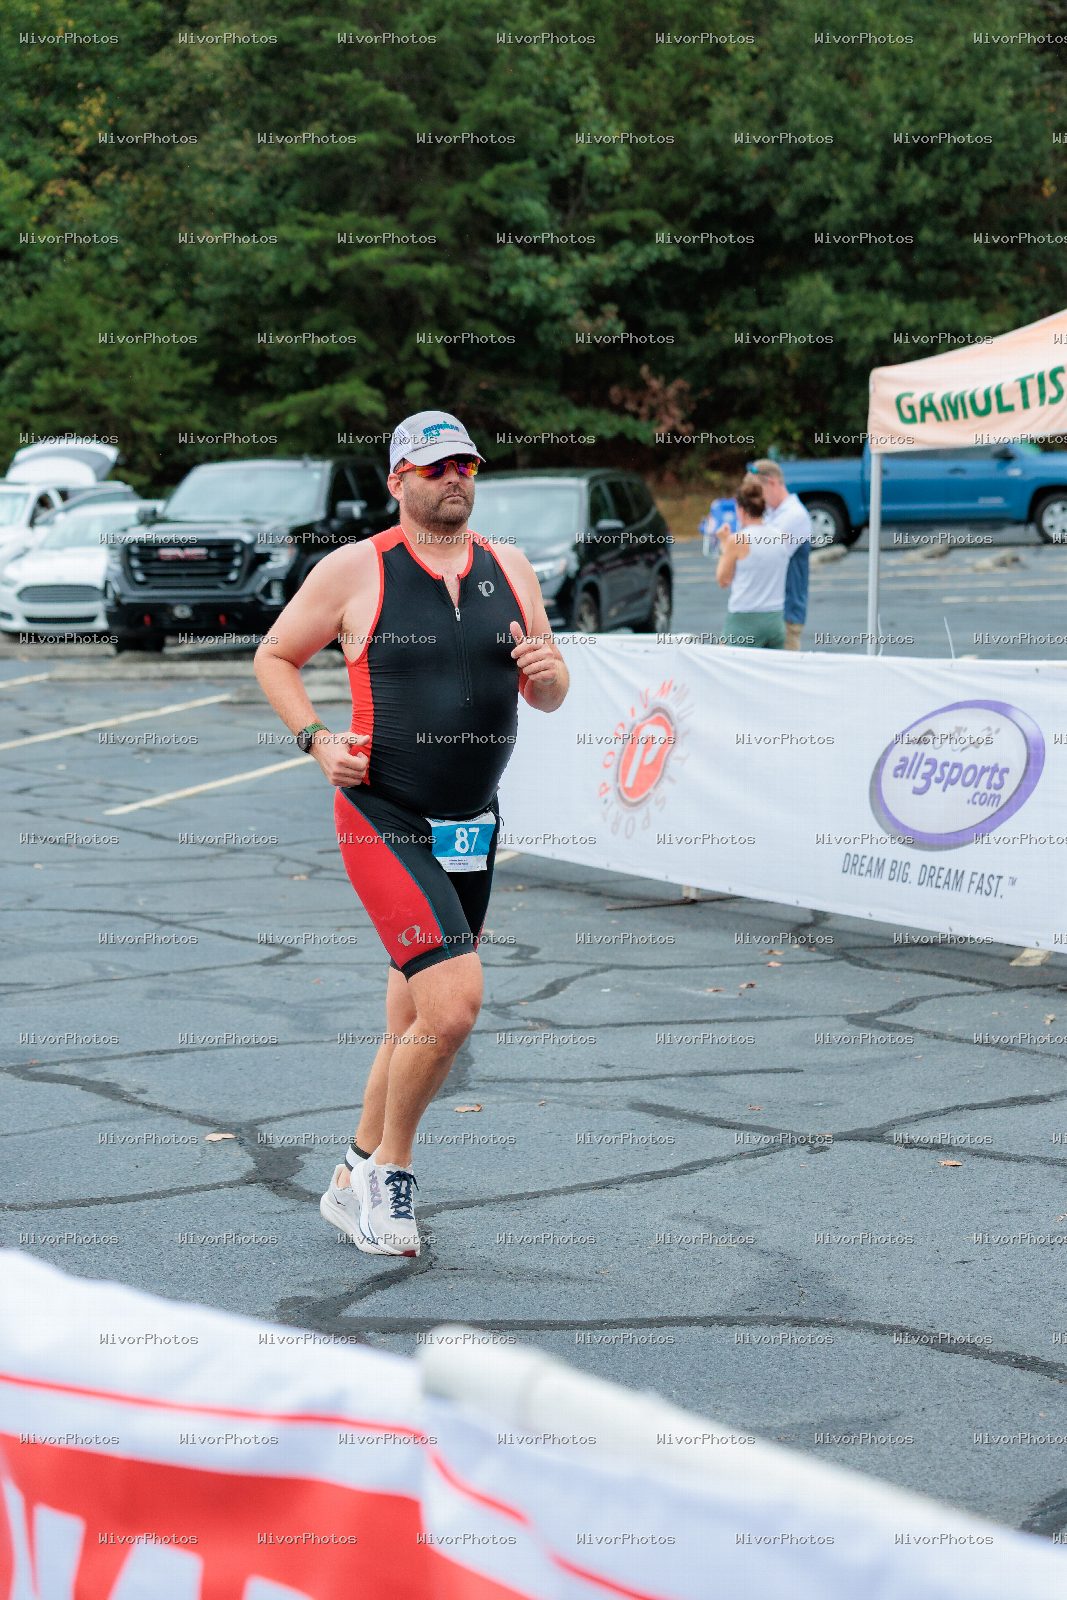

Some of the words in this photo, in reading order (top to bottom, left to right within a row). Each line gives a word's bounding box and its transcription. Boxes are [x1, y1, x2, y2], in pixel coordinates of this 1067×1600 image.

[895, 364, 1066, 425] GAMULTIS
[892, 751, 1010, 796] all3sports
[966, 790, 1002, 808] .com
[454, 827, 480, 854] 87
[841, 851, 887, 880] DREAM
[888, 858, 912, 885] BIG.
[917, 863, 965, 893] DREAM
